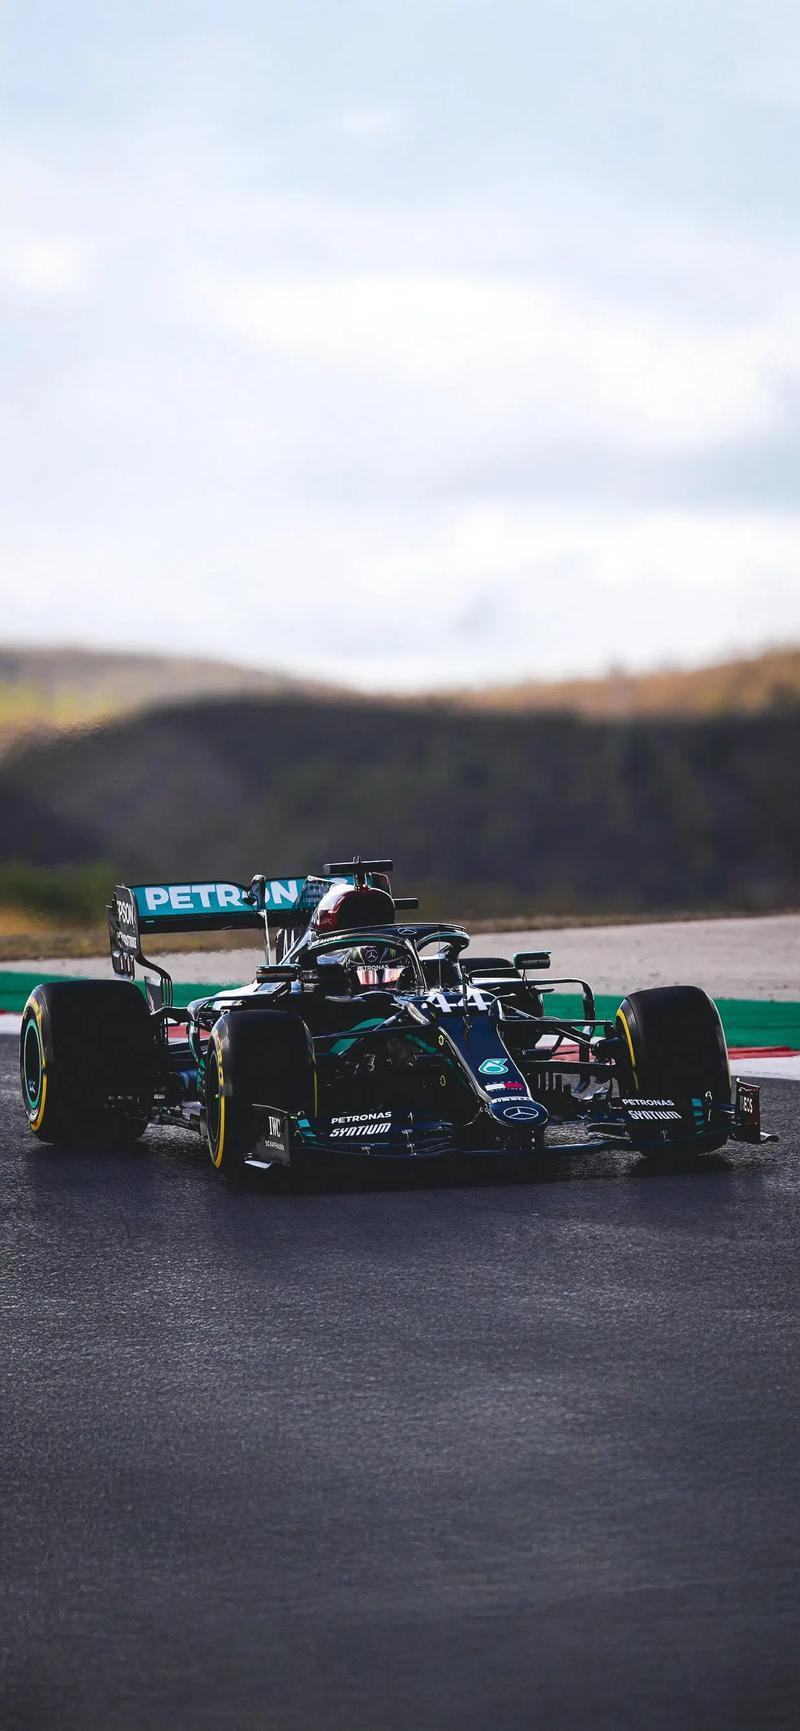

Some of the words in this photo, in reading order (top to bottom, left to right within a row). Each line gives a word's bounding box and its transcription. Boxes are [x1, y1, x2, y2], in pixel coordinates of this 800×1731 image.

[621, 1098, 675, 1107] PETRONAS
[330, 1111, 392, 1125] PETRONAS
[268, 1116, 281, 1138] IWC
